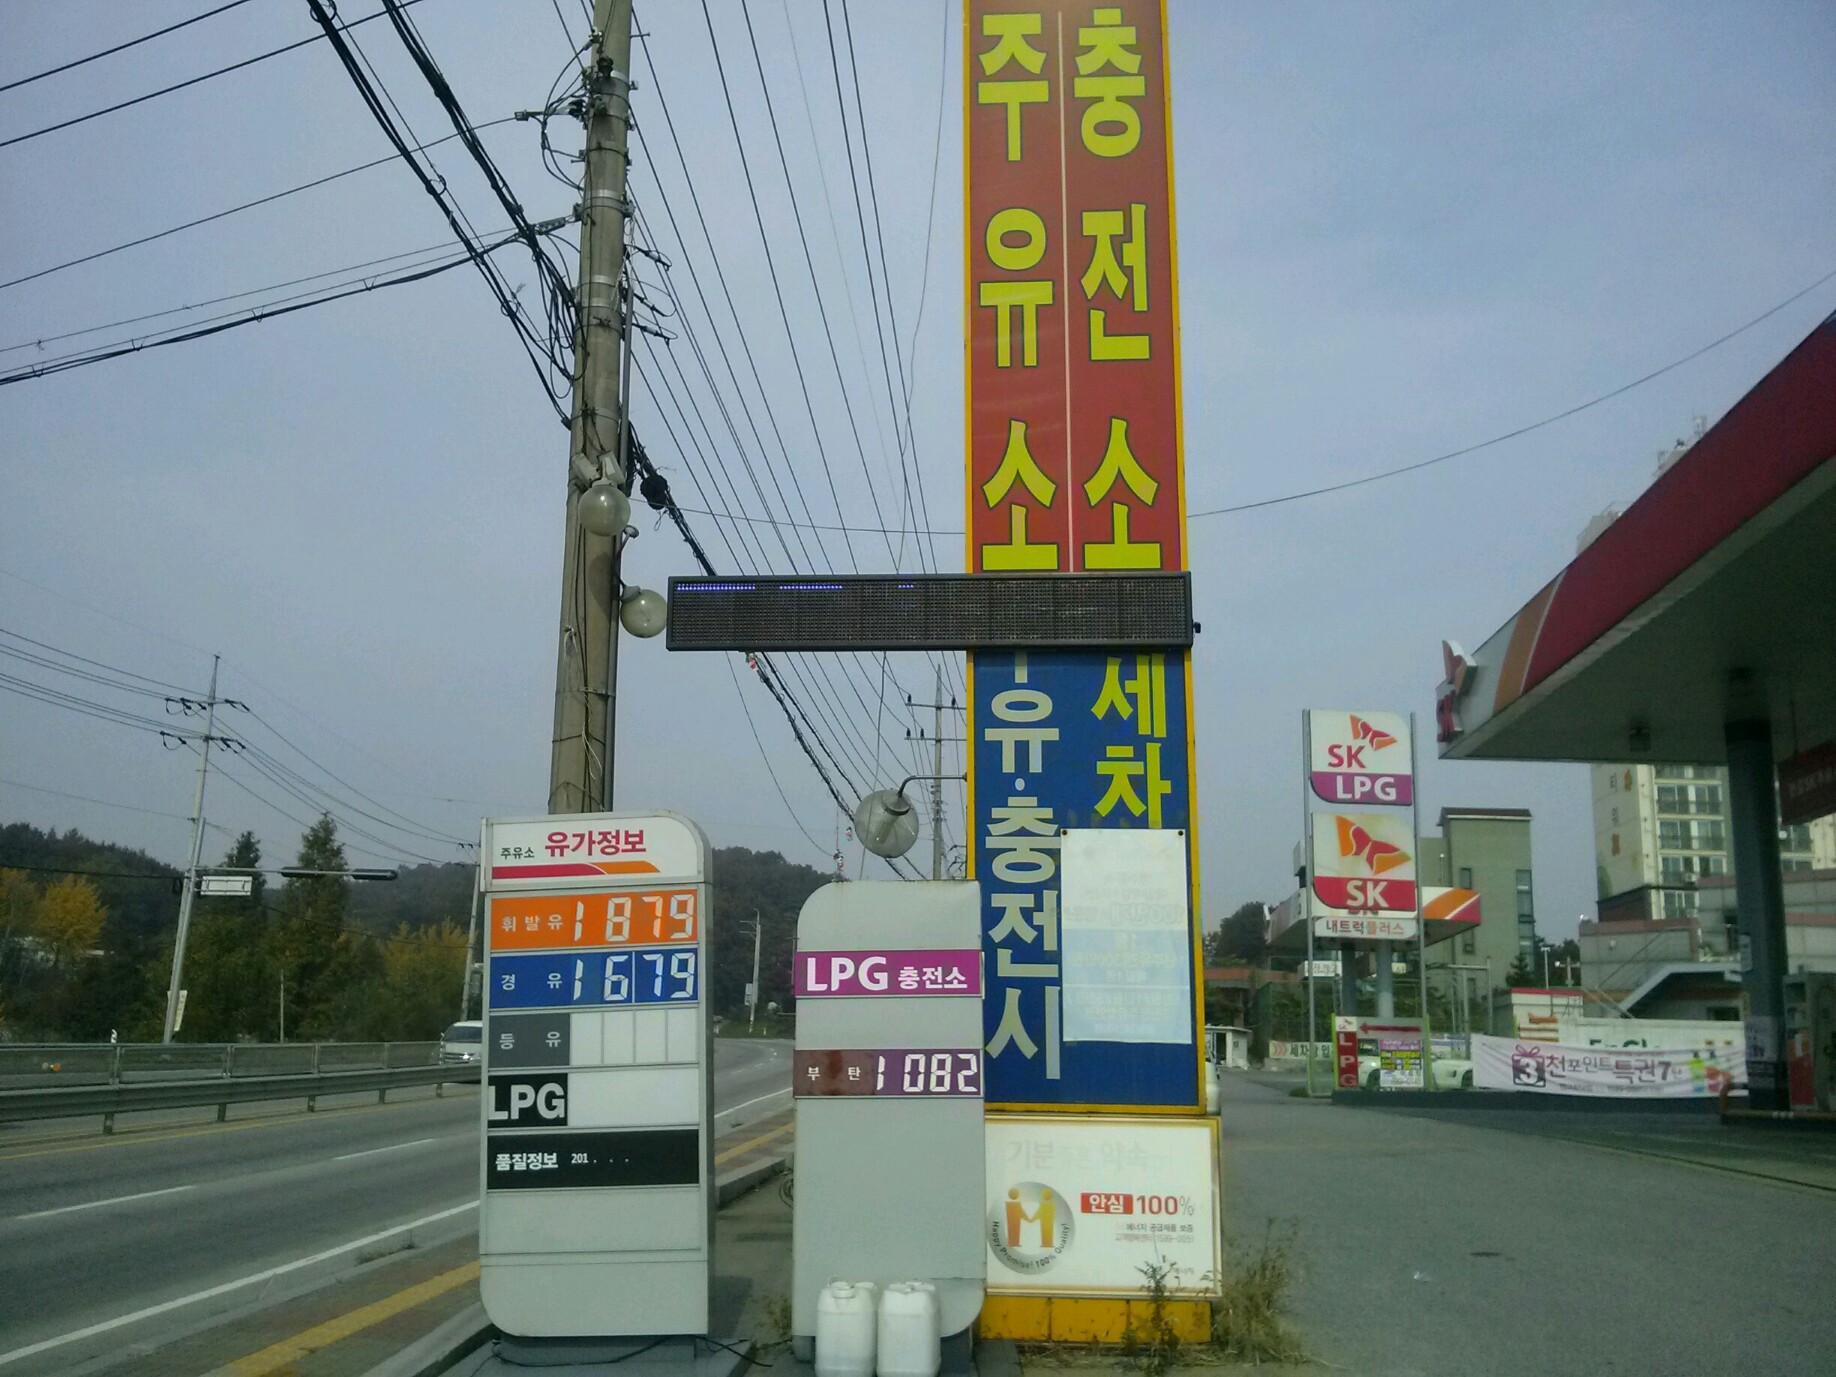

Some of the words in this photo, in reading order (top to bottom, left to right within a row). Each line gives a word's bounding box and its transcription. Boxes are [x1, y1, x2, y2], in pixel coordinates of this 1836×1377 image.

[978, 13, 1059, 571] 주유소
[1073, 8, 1161, 571] 충전소
[1090, 653, 1172, 829] 세차
[1327, 744, 1367, 769] SK
[1335, 775, 1397, 801] LPG
[500, 847, 536, 860] 주유소
[544, 829, 647, 858] 유가정보
[1346, 879, 1390, 909] SK
[573, 893, 695, 942] 1879
[572, 951, 695, 1001] 1679
[806, 956, 889, 991] LPG
[898, 966, 968, 990] 충전소
[876, 1053, 978, 1092] 1082
[488, 1081, 566, 1121] LPG
[495, 1152, 558, 1171] 품질정보
[1089, 1194, 1124, 1213] 안심
[1136, 1196, 1194, 1216] 100%
